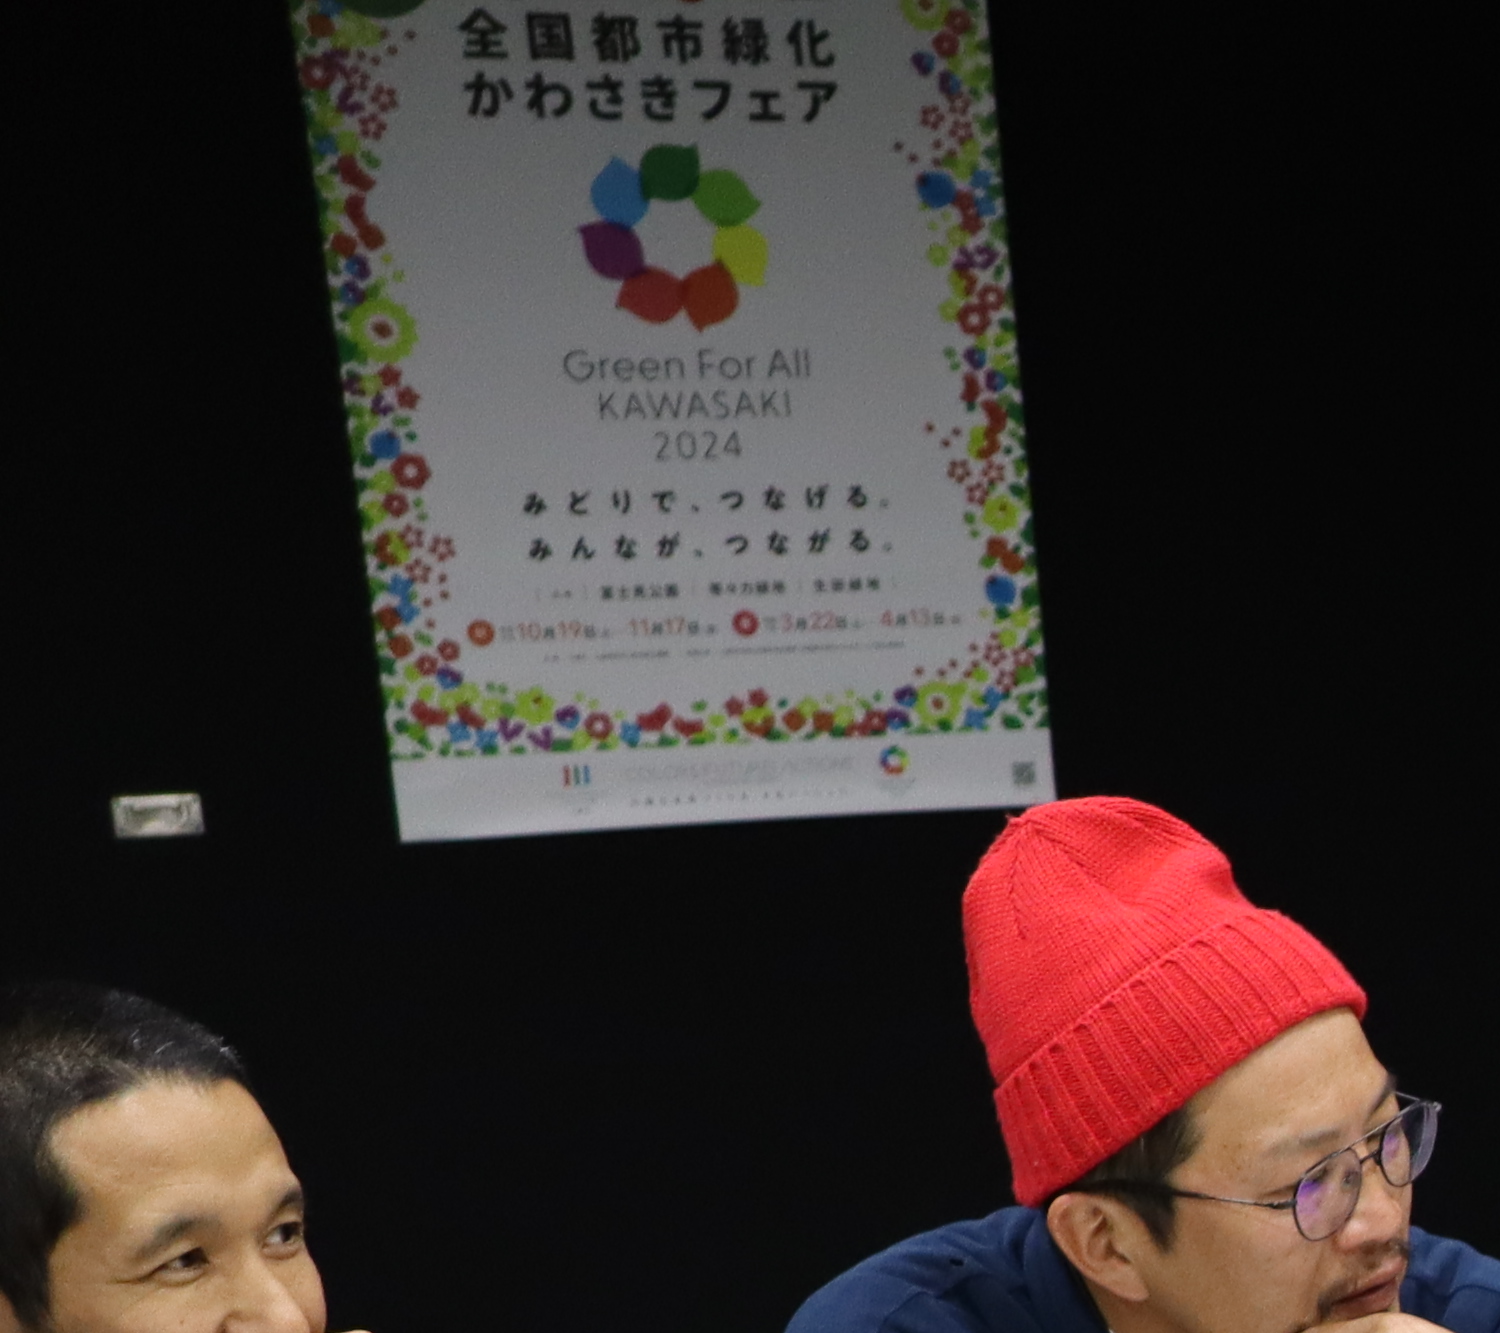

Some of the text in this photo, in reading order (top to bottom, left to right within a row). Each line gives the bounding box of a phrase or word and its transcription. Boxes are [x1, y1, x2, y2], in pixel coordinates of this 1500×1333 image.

[458, 8, 837, 69] 全国都市緑化
[463, 72, 839, 123] かわさきフェア
[562, 347, 812, 383] Green For All
[598, 389, 793, 421] KAWASAKI
[654, 431, 743, 461] 2024
